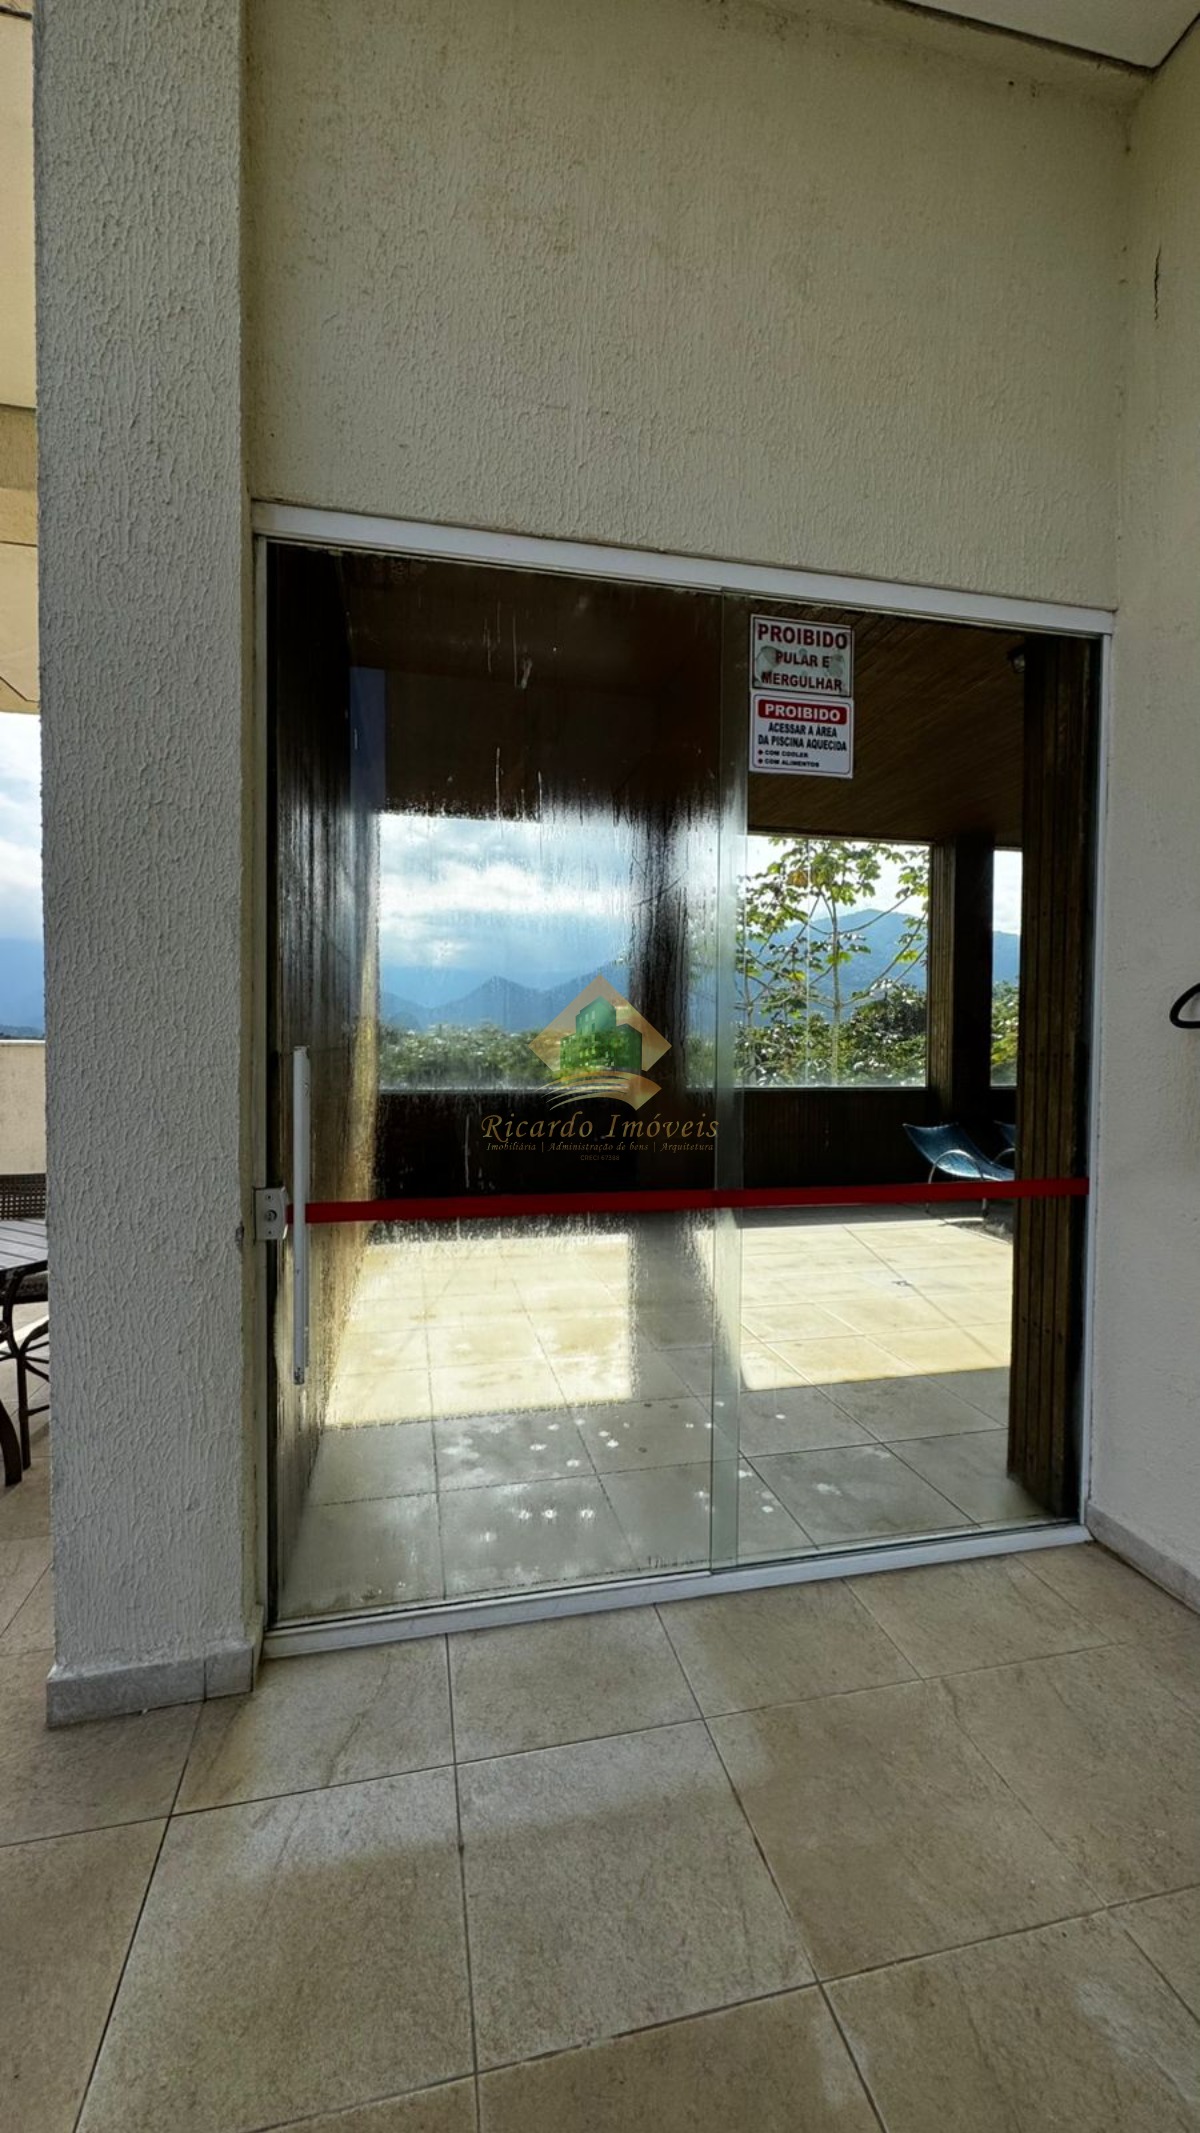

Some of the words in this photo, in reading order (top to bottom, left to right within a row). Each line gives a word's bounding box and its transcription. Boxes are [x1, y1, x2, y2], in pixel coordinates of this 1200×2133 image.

[757, 623, 848, 650] PROIBIDO
[775, 650, 818, 668] PULAR
[822, 655, 831, 669] E
[761, 671, 843, 692] MERGULHAR
[764, 703, 841, 722] PROIBIDO
[768, 721, 806, 736] ACESSAR
[808, 726, 814, 736] A
[758, 734, 769, 746] DA
[771, 735, 805, 749] PISCINA
[806, 738, 847, 752] AQUECIDA
[781, 750, 809, 759] COOLER
[781, 759, 820, 768] ALIMENTOS
